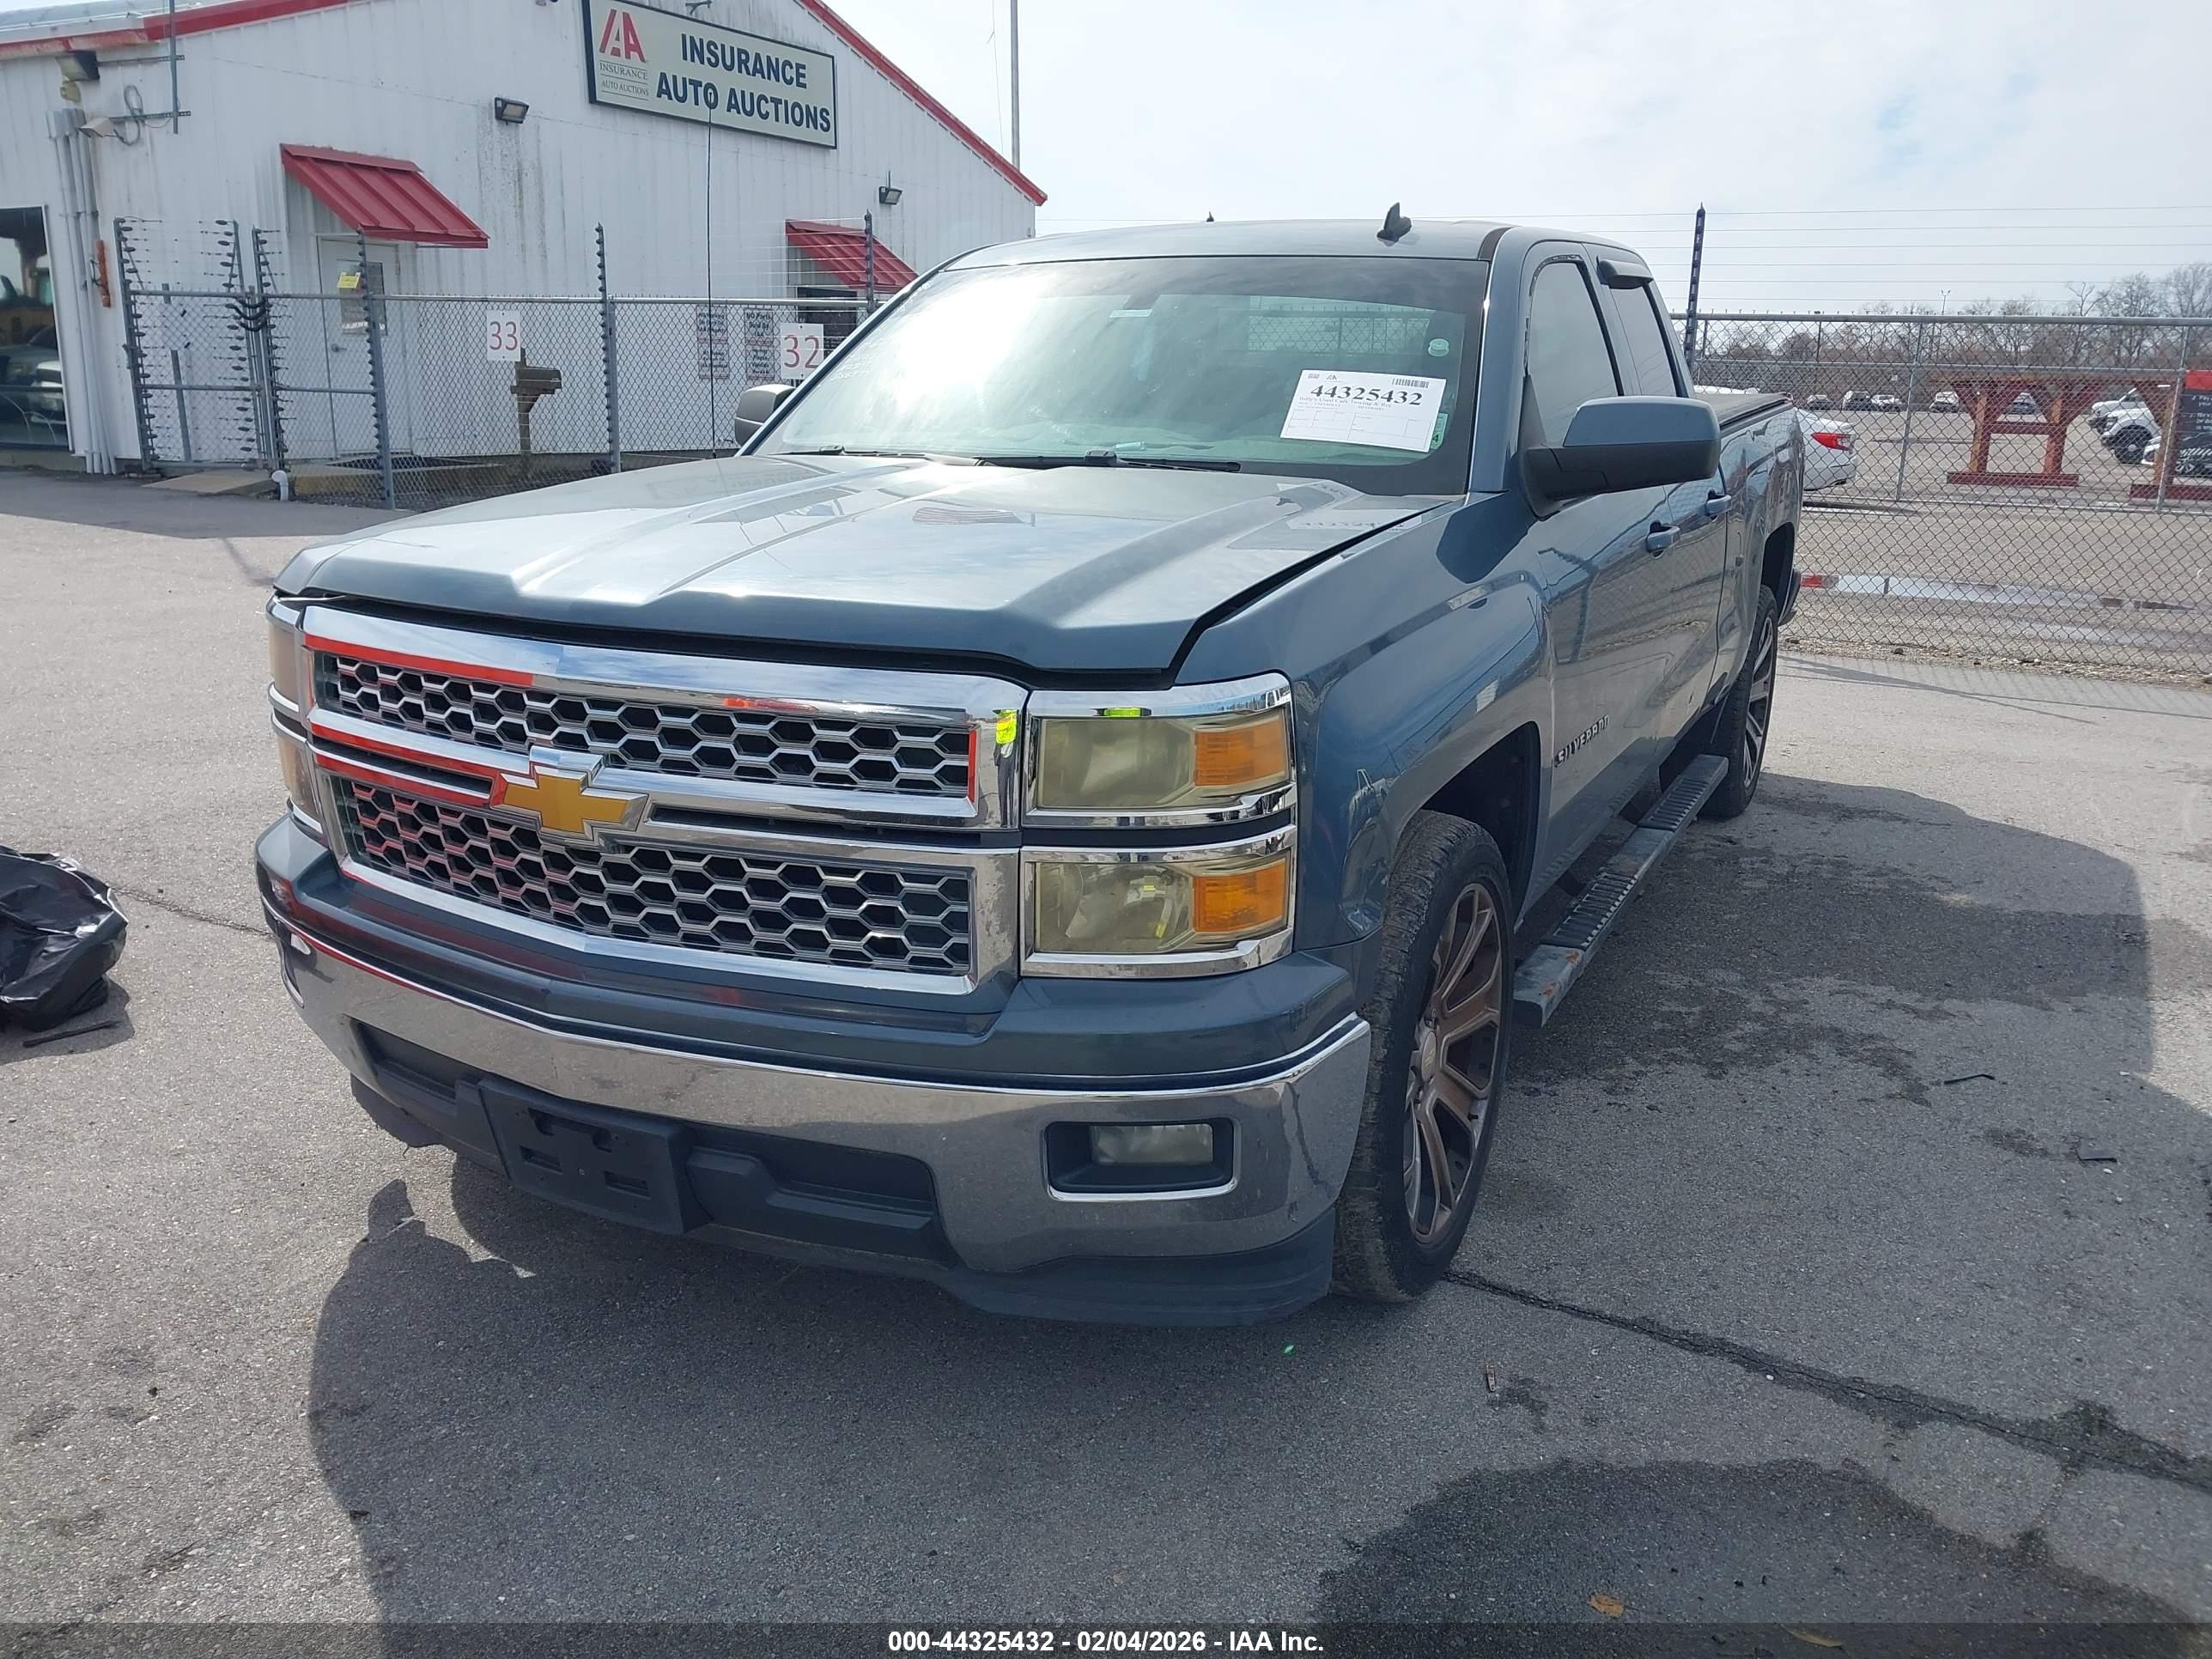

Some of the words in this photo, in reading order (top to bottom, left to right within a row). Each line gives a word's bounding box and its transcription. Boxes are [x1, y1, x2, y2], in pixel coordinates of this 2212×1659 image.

[599, 62, 648, 81] INSURANCE
[681, 33, 808, 89] INSURANCE
[602, 79, 619, 91] AUTO
[619, 83, 650, 96] AUCTIONS
[656, 71, 719, 110] AUTO
[726, 87, 831, 132] AUCTIONS
[489, 321, 518, 350] 33
[783, 334, 820, 369] 32
[1310, 384, 1423, 406] 44325432
